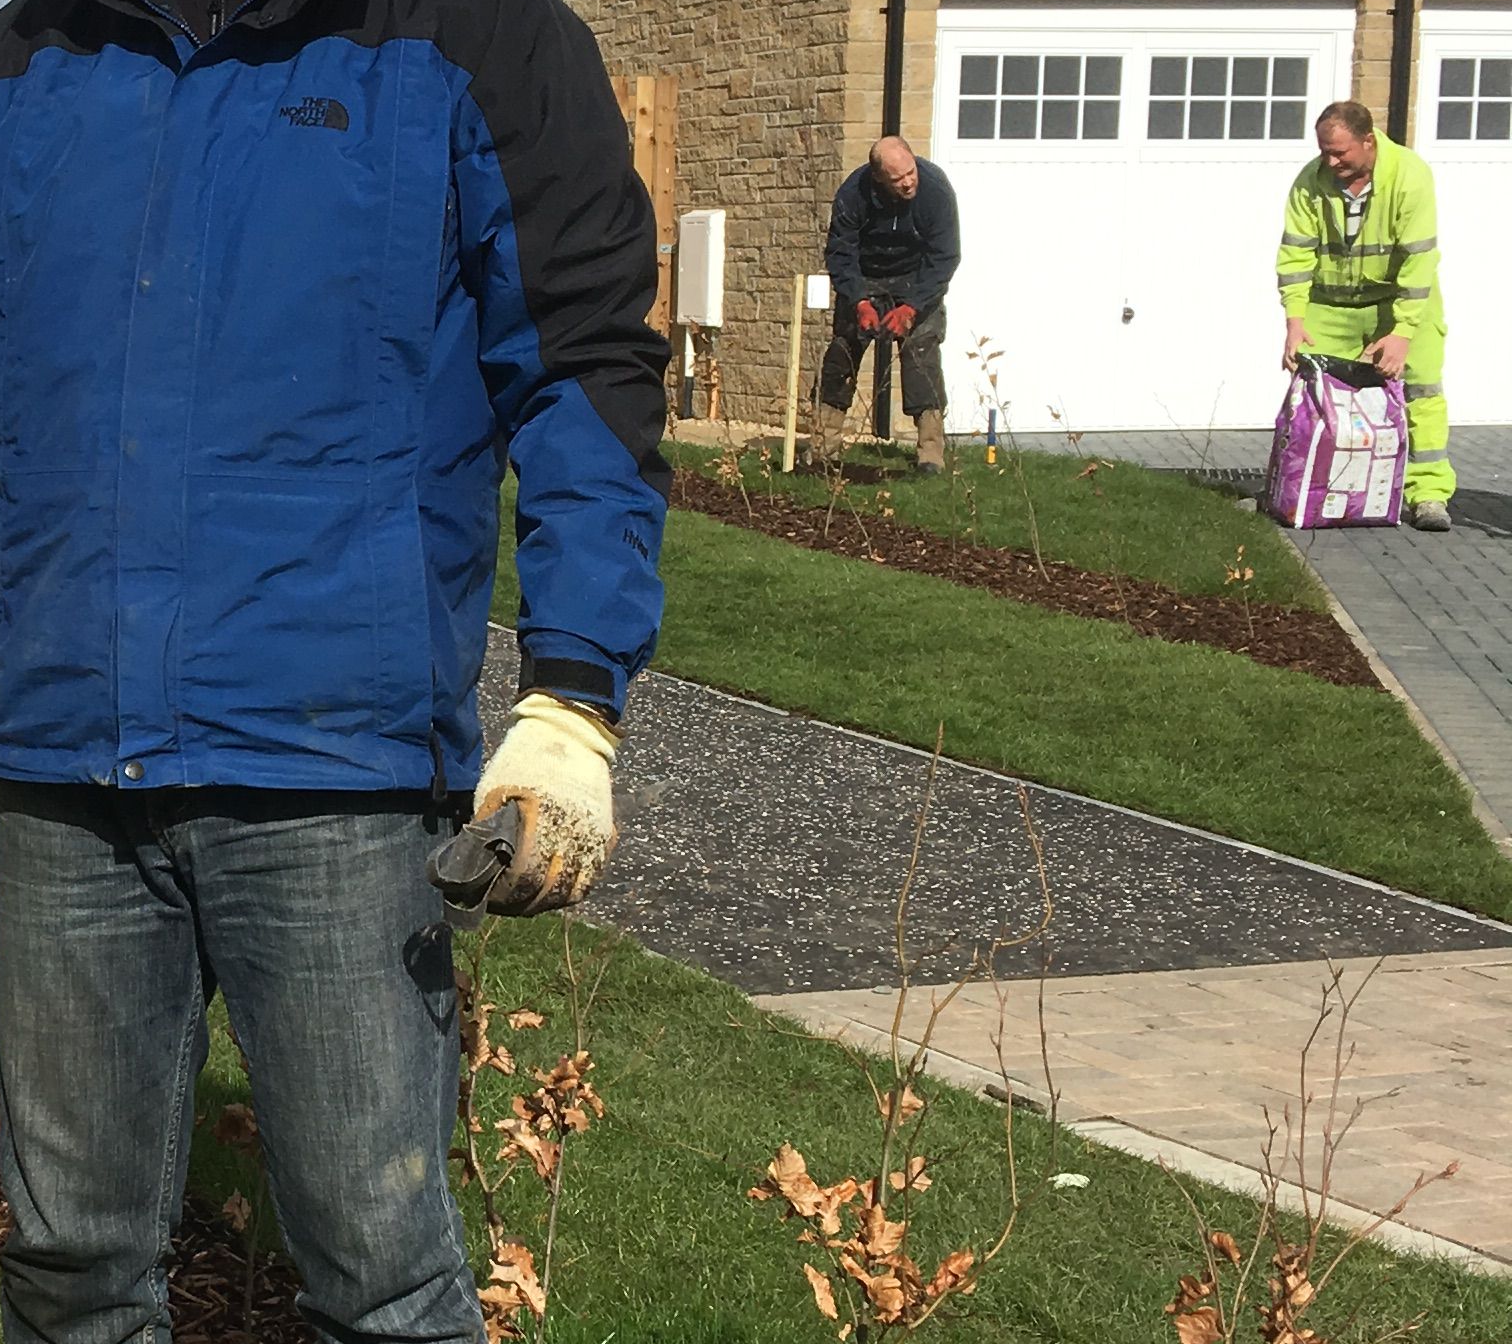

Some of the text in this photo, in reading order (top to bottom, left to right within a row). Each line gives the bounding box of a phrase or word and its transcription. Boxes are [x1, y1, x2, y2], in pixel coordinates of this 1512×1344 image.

[302, 97, 327, 107] THE
[279, 106, 325, 118] NORTH
[289, 116, 324, 127] FACE
